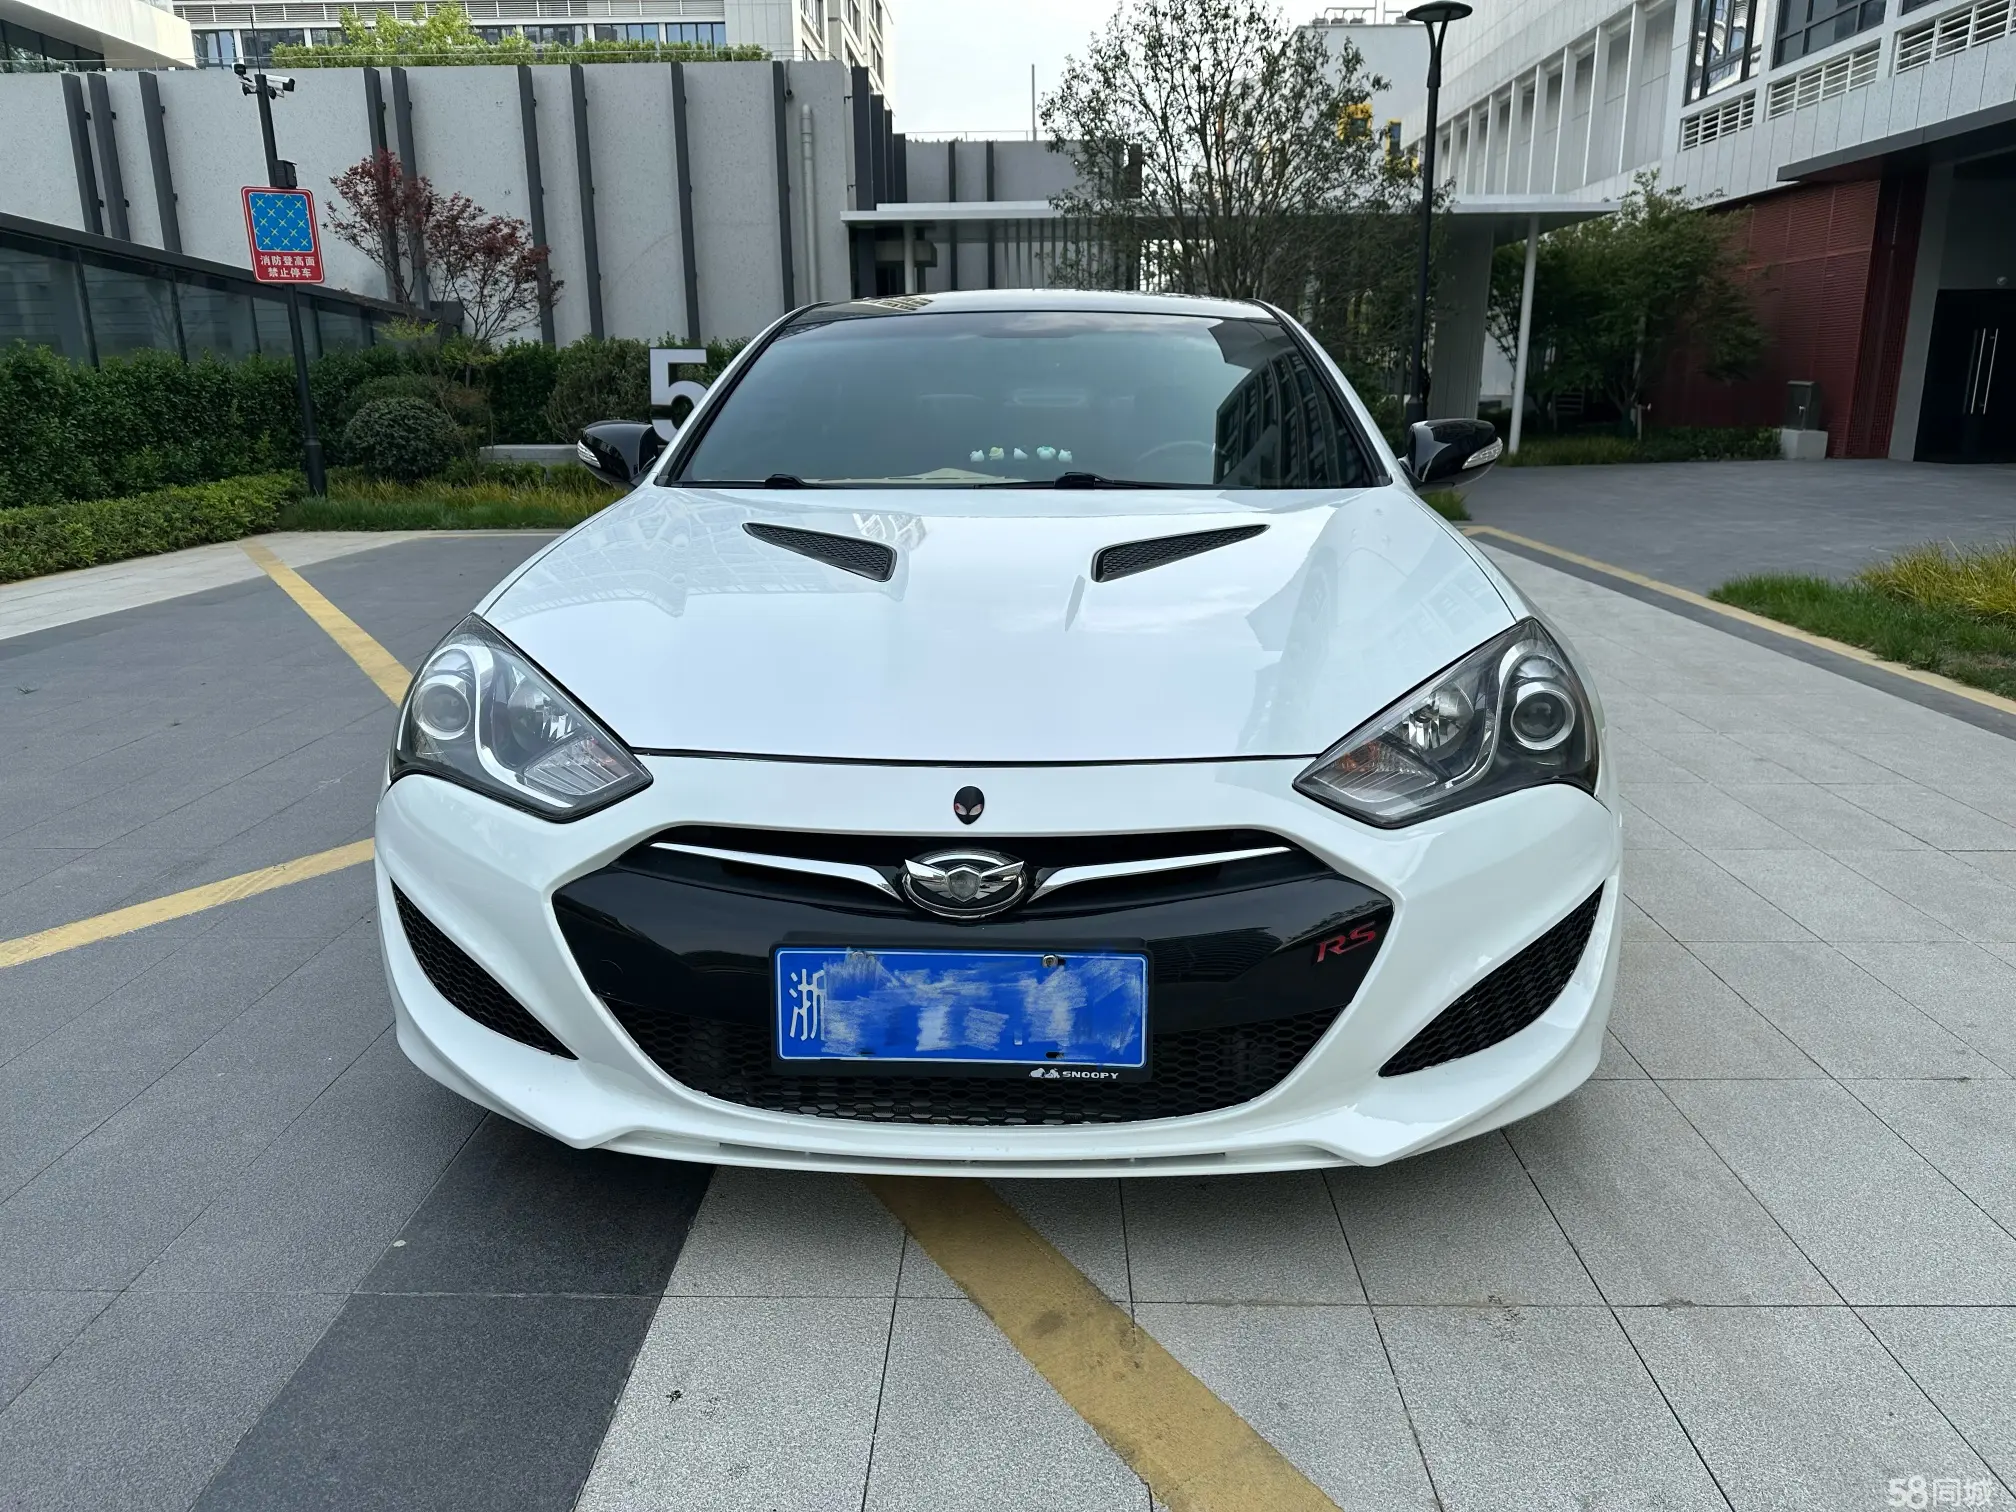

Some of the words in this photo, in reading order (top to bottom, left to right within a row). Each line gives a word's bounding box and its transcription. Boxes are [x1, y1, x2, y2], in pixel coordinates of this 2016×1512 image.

[260, 255, 315, 266] 消防登高面
[268, 267, 312, 277] 禁止停车
[650, 348, 708, 442] 5
[1316, 921, 1377, 963] RS
[1062, 1071, 1119, 1080] SNOOPY
